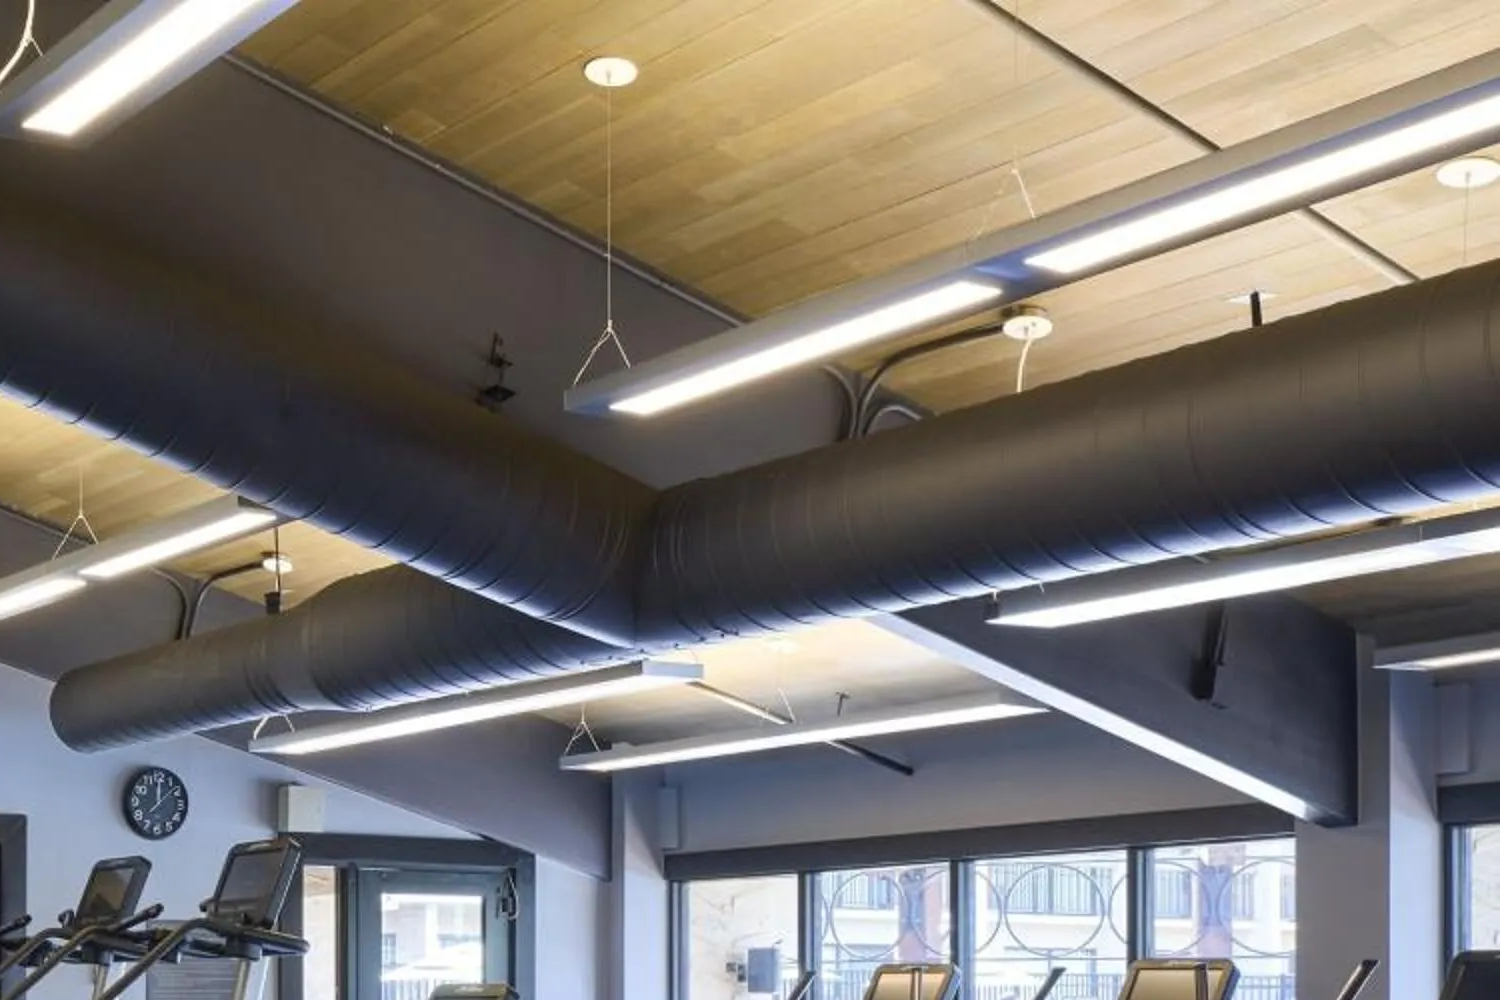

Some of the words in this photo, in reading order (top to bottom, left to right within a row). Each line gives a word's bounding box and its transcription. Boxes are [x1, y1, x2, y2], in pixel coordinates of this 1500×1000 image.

[154, 771, 165, 783] 12
[134, 785, 148, 796] 10
[131, 796, 140, 807] 9
[133, 809, 143, 821] 8
[143, 819, 151, 830] 7
[153, 824, 162, 835] 6
[165, 821, 173, 833] 5
